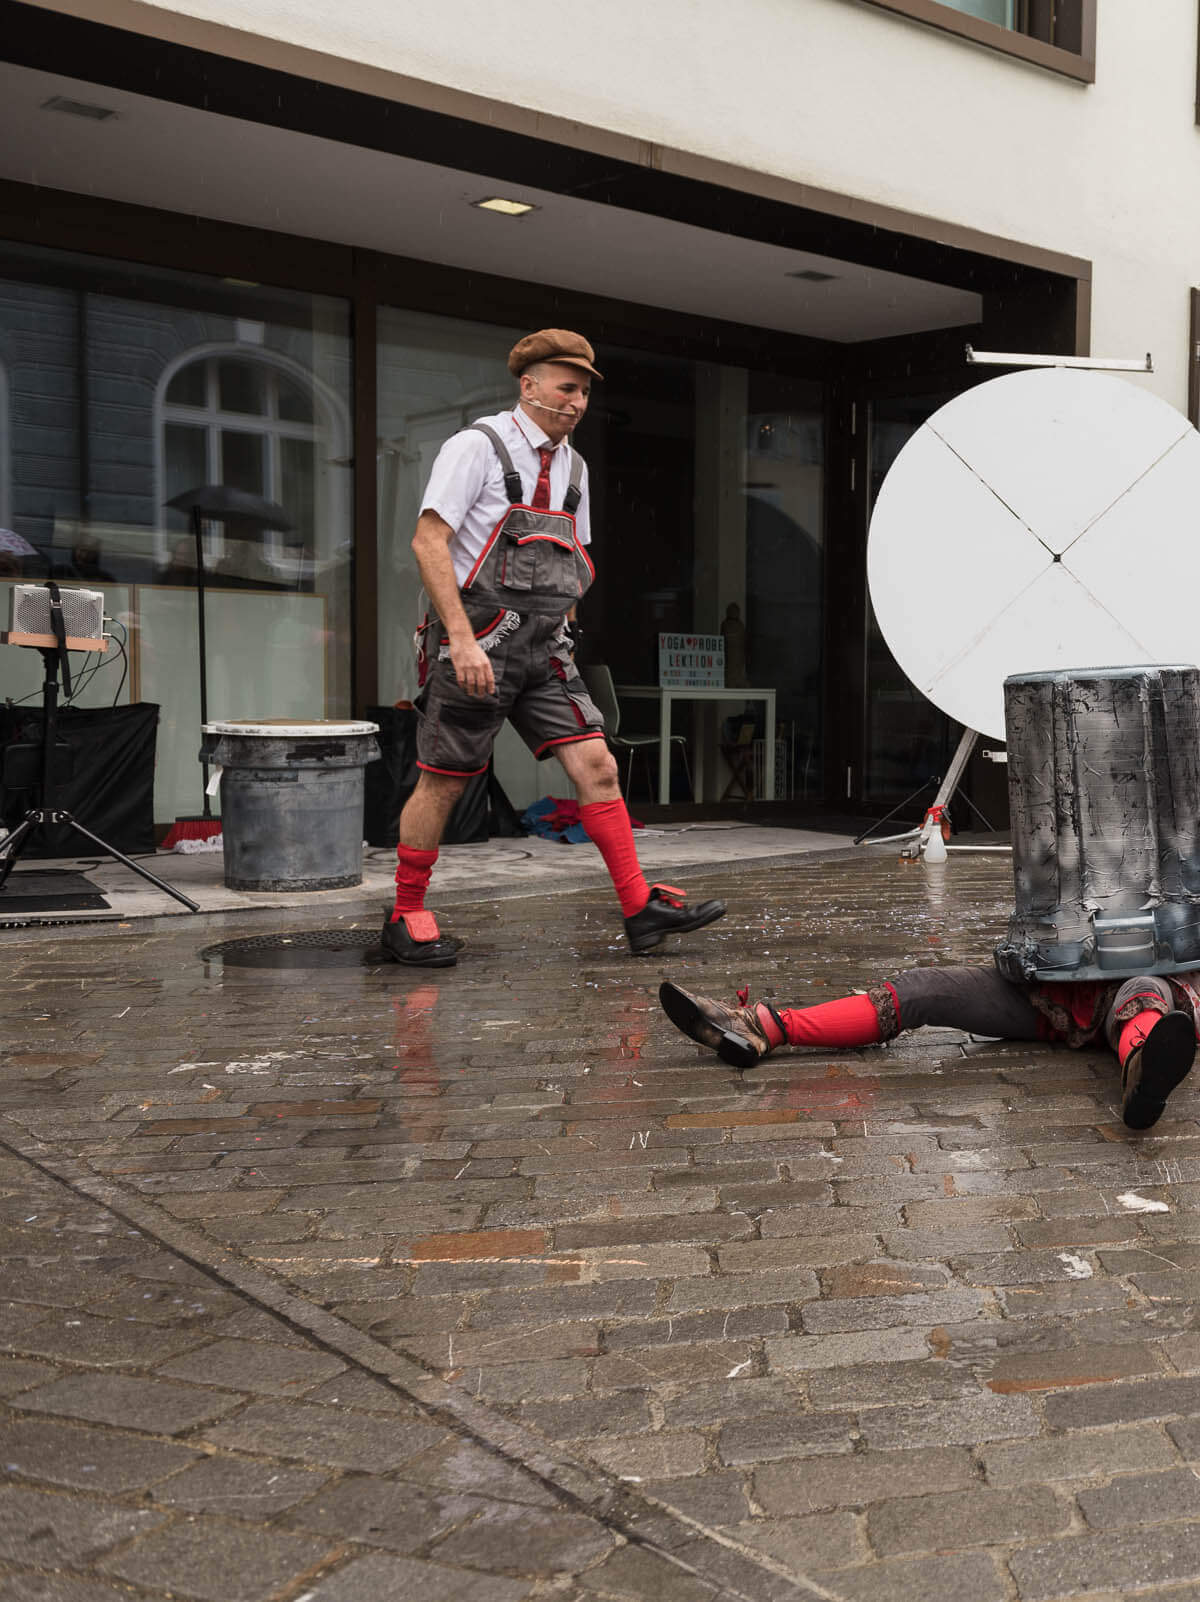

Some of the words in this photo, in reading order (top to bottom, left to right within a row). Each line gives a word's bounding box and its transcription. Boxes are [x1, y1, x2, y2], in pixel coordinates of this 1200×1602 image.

[660, 635, 685, 650] YOGA
[692, 637, 722, 651] PROBE
[669, 654, 712, 668] LEKTION
